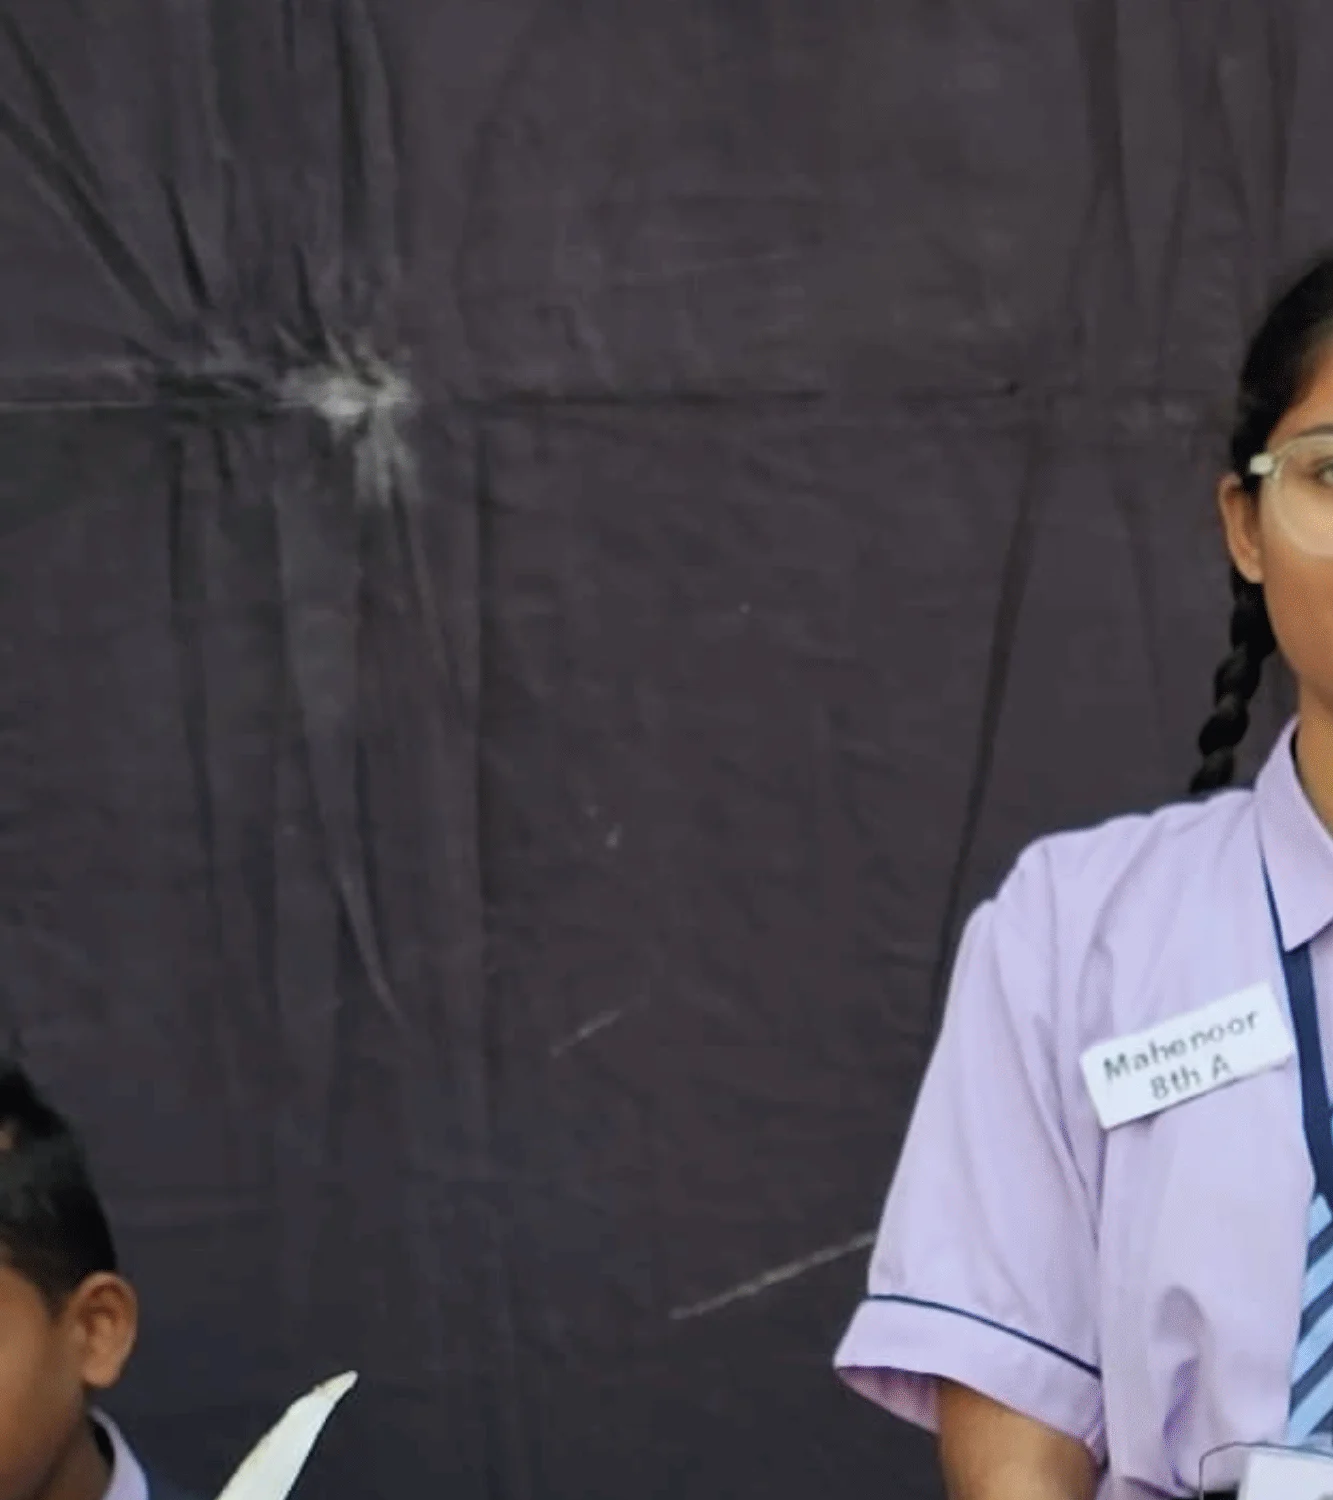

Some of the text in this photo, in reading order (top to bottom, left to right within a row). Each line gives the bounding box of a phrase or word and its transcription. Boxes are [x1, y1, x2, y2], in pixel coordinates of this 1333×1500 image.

[1102, 1010, 1259, 1083] Mahenoor
[1151, 1053, 1231, 1101] 8th A
